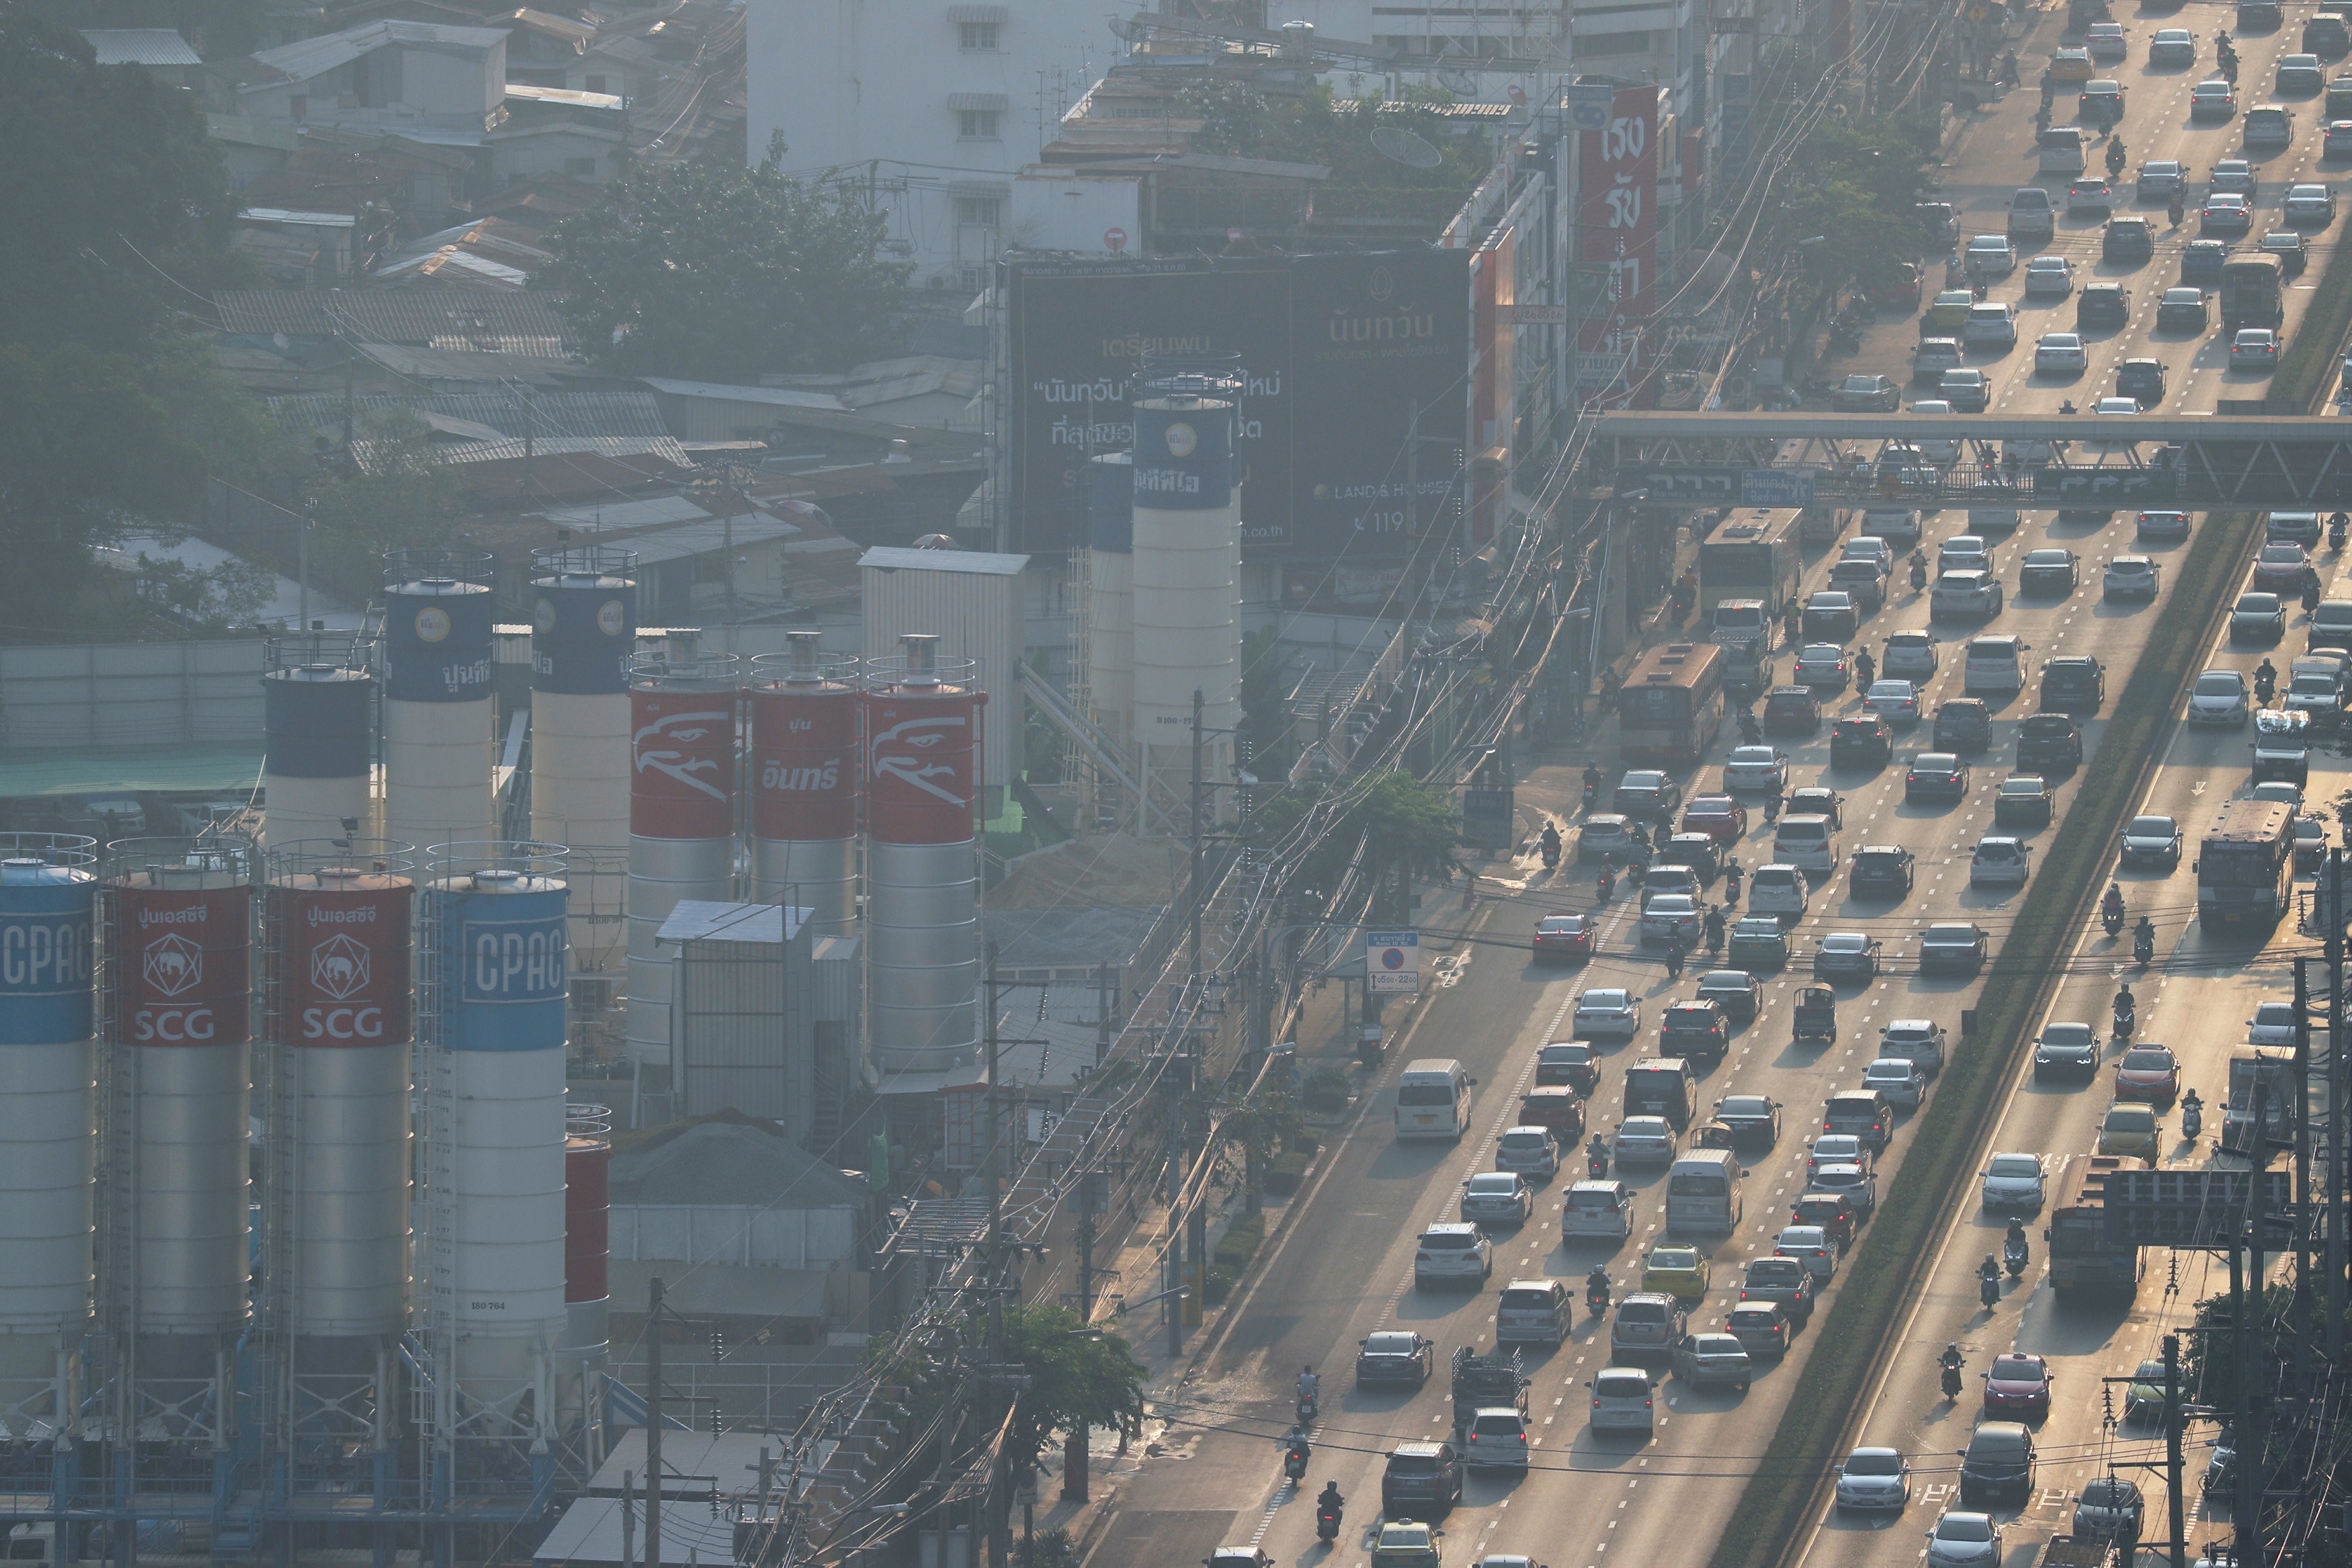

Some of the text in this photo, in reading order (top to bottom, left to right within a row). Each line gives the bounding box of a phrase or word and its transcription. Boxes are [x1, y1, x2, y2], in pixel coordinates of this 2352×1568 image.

[1606, 172, 1640, 229] รับ
[1330, 302, 1433, 341] นันทวัน
[1579, 306, 1606, 316] ATM
[1103, 333, 1210, 357] เตรียมพบ
[1576, 380, 1596, 388] Drug
[1335, 480, 1452, 499] LAND & HUSES
[1374, 512, 1416, 533] 119
[790, 717, 812, 734] ปูน
[763, 758, 841, 790] อินทรี
[138, 904, 207, 929] ปูนเอสซีจี
[307, 905, 376, 928] ปูนเอสซีจี
[2, 922, 90, 985] CPAC
[476, 927, 563, 992] CPAC
[134, 1008, 215, 1041] SCG
[303, 1007, 383, 1039] SCG
